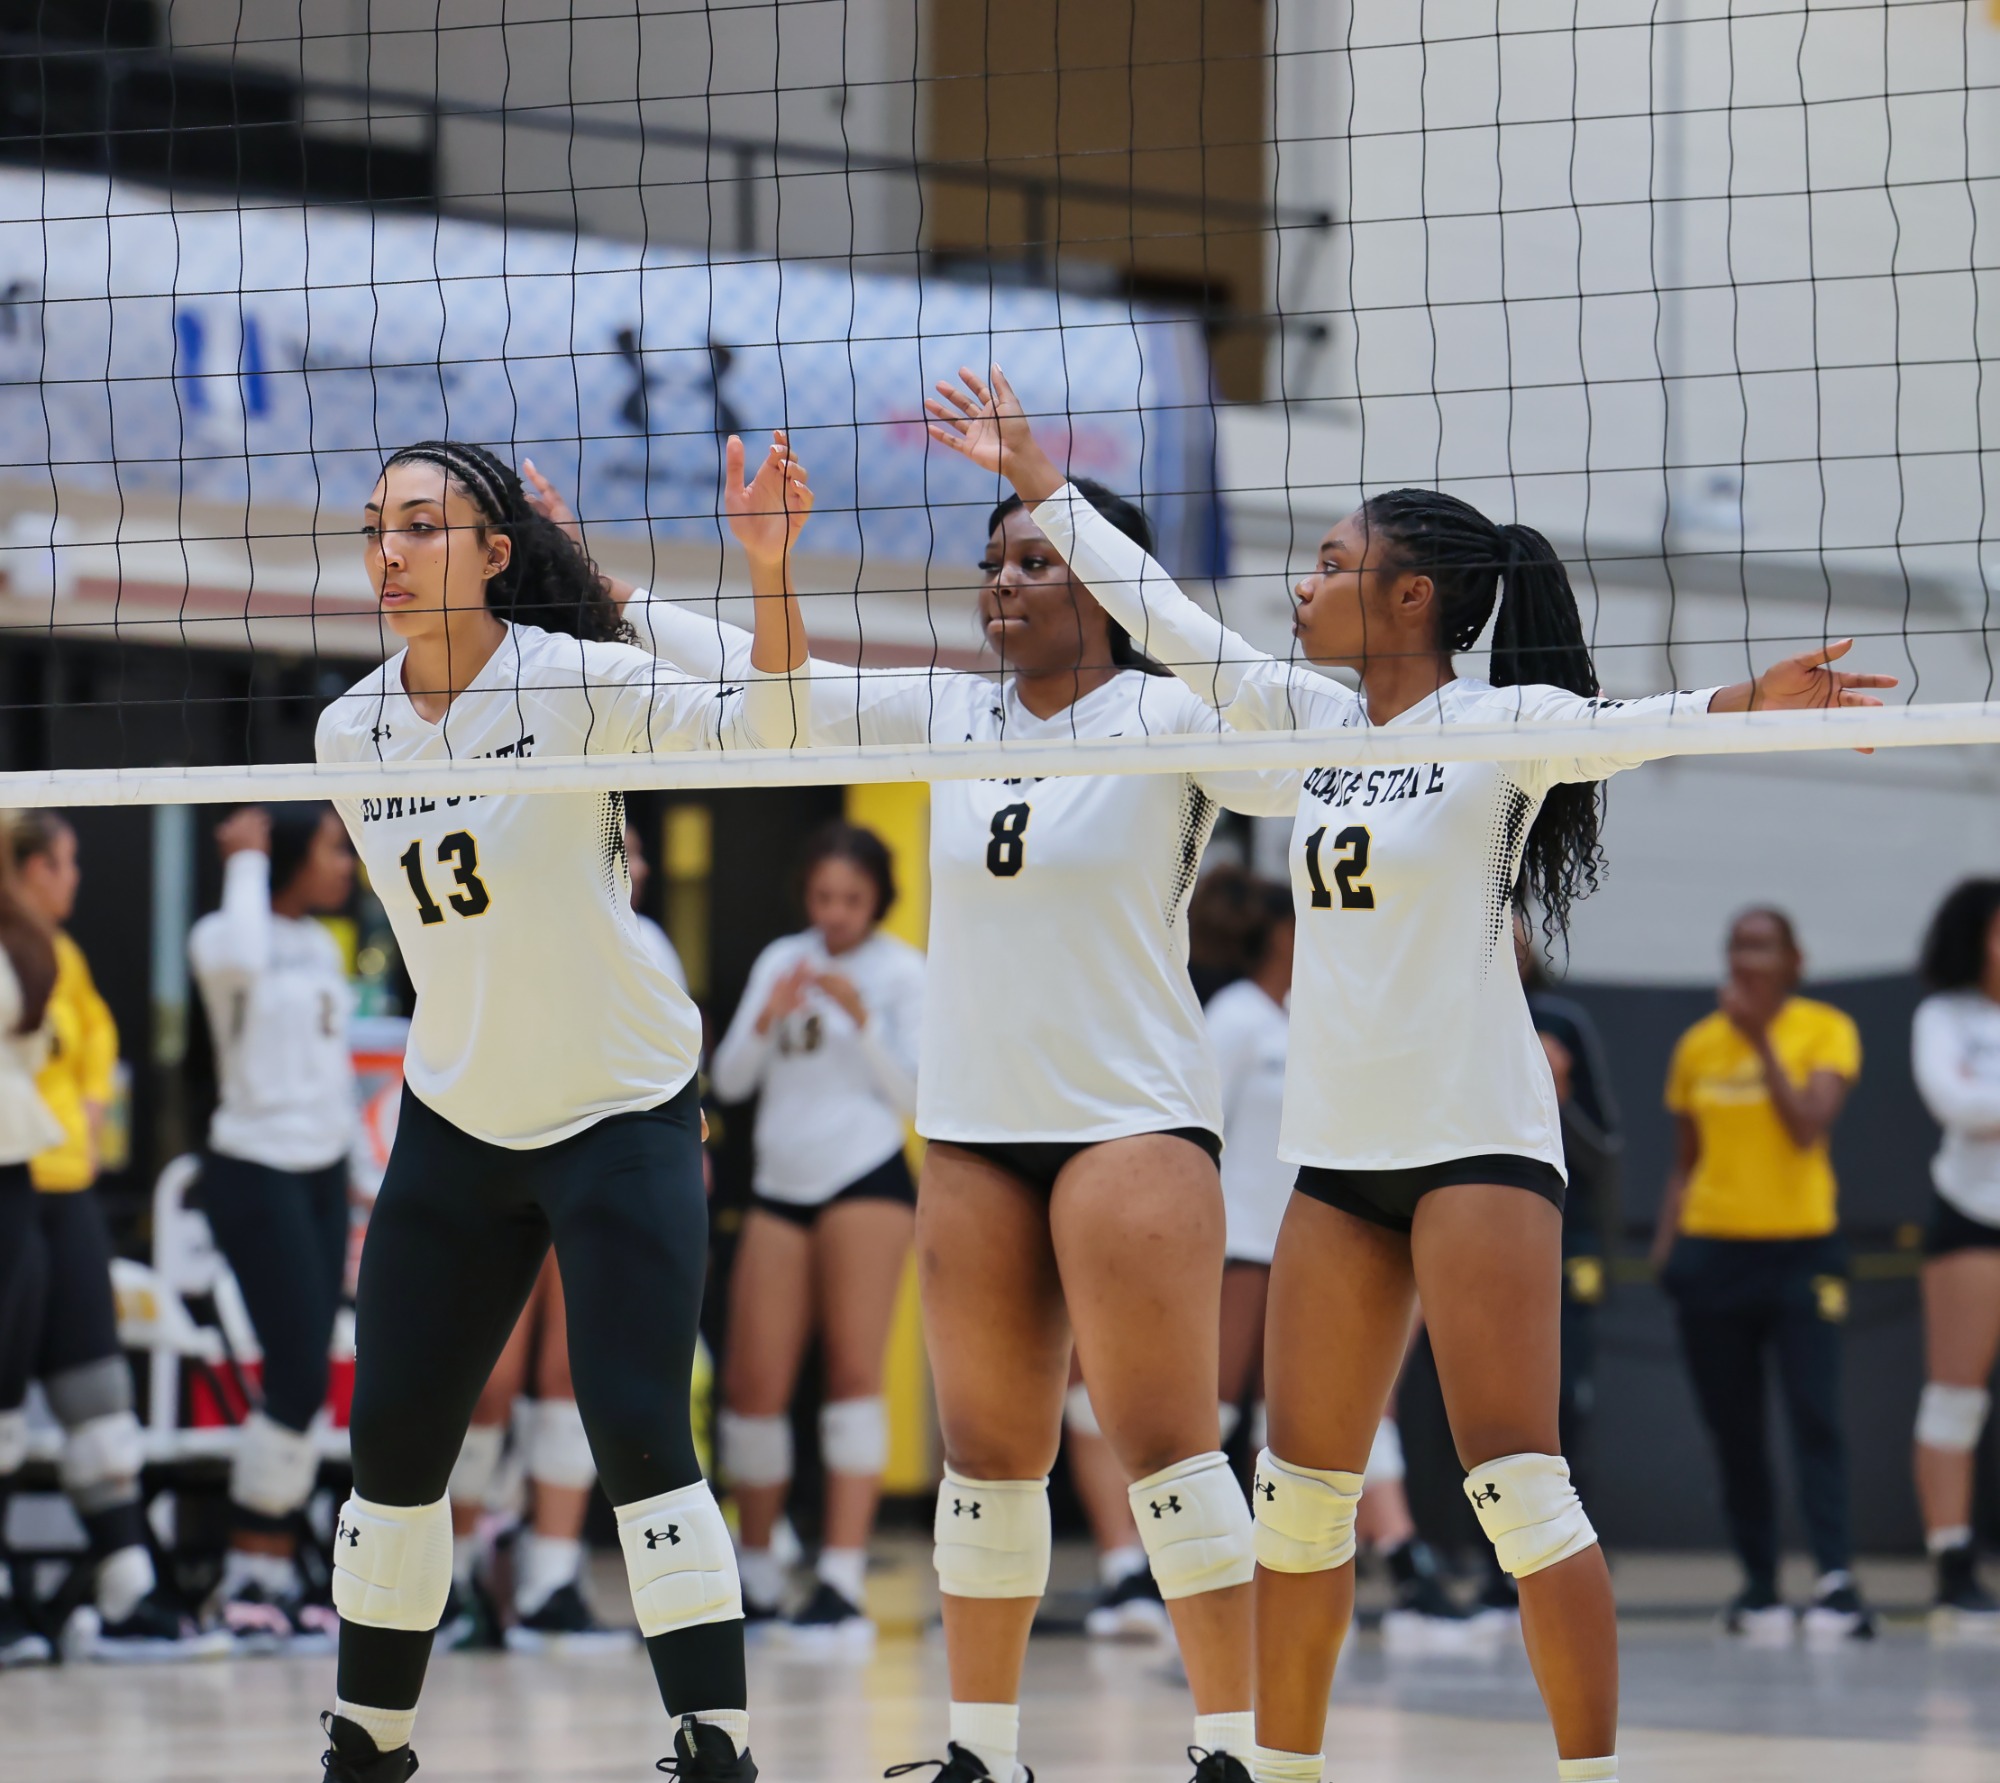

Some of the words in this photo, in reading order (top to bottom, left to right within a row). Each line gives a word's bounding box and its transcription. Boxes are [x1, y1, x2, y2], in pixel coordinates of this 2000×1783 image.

[399, 828, 493, 927] 13
[986, 801, 1033, 880] 8
[1303, 824, 1376, 912] 12
